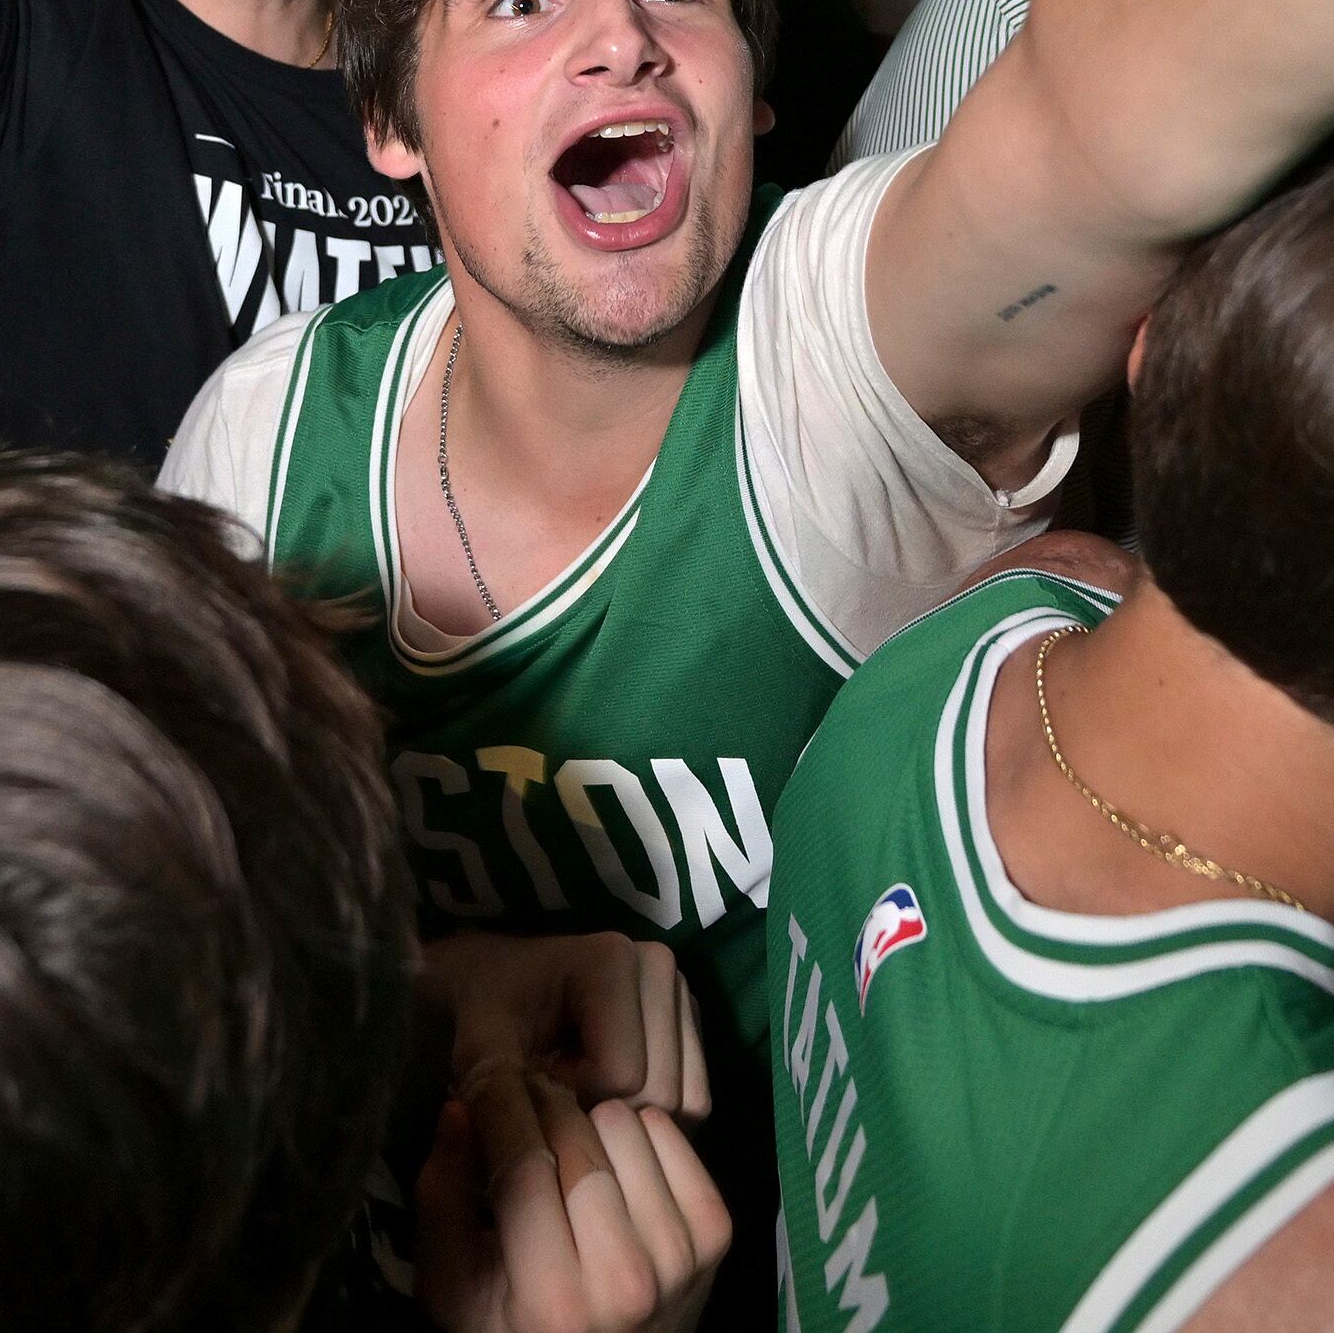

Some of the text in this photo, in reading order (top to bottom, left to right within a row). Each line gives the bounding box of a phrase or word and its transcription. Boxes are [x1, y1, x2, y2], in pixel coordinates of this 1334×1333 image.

[347, 194, 419, 228] 202
[389, 744, 774, 931] STON
[783, 912, 890, 1333] TATUM
